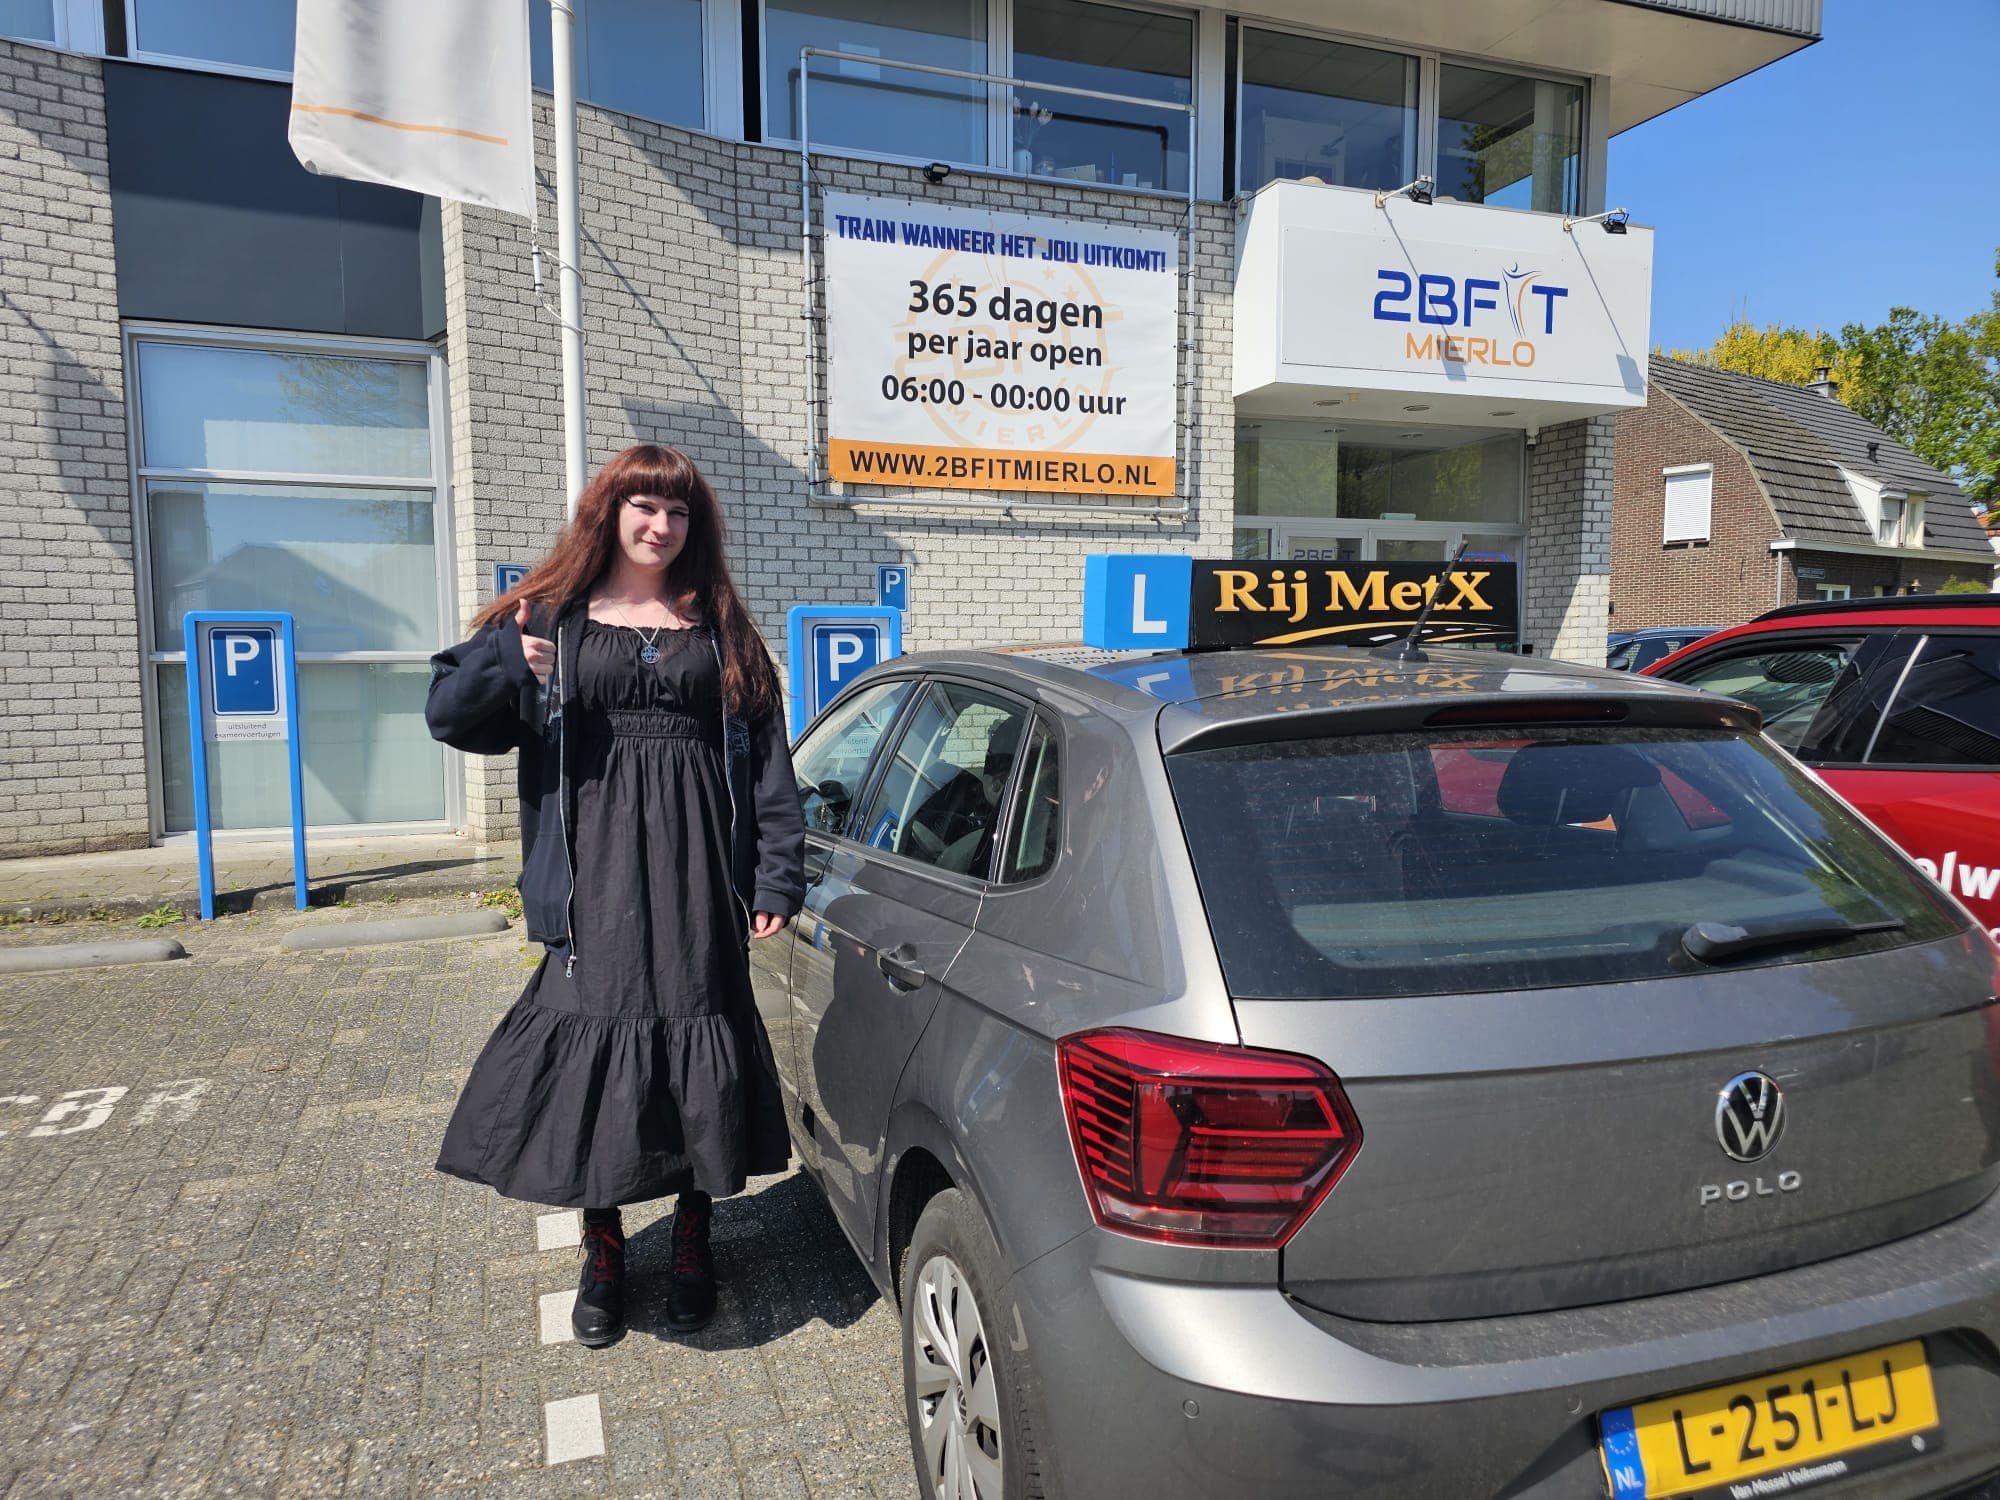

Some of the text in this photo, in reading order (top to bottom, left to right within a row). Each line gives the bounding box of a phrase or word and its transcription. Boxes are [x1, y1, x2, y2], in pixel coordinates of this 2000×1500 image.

[835, 214, 1168, 273] TRAIN WANNEER HET JOU UITKOMT!
[908, 280, 1104, 333] 365 dagen
[908, 329, 1103, 370] per jaar open
[1405, 331, 1536, 368] MIERLO
[881, 374, 965, 406] 06:00
[989, 382, 1071, 412] 00:00
[1078, 394, 1127, 416] uur
[849, 449, 1158, 486] WWW.2BFITMIERLO.NL
[885, 570, 901, 593] P
[1213, 569, 1310, 623] Rij
[1132, 573, 1168, 634] L
[225, 634, 260, 677] P
[829, 632, 864, 682] P
[1699, 1170, 1802, 1206] POLO
[1671, 1359, 1897, 1475] L-251-LJ
[1614, 1465, 1643, 1493] NL
